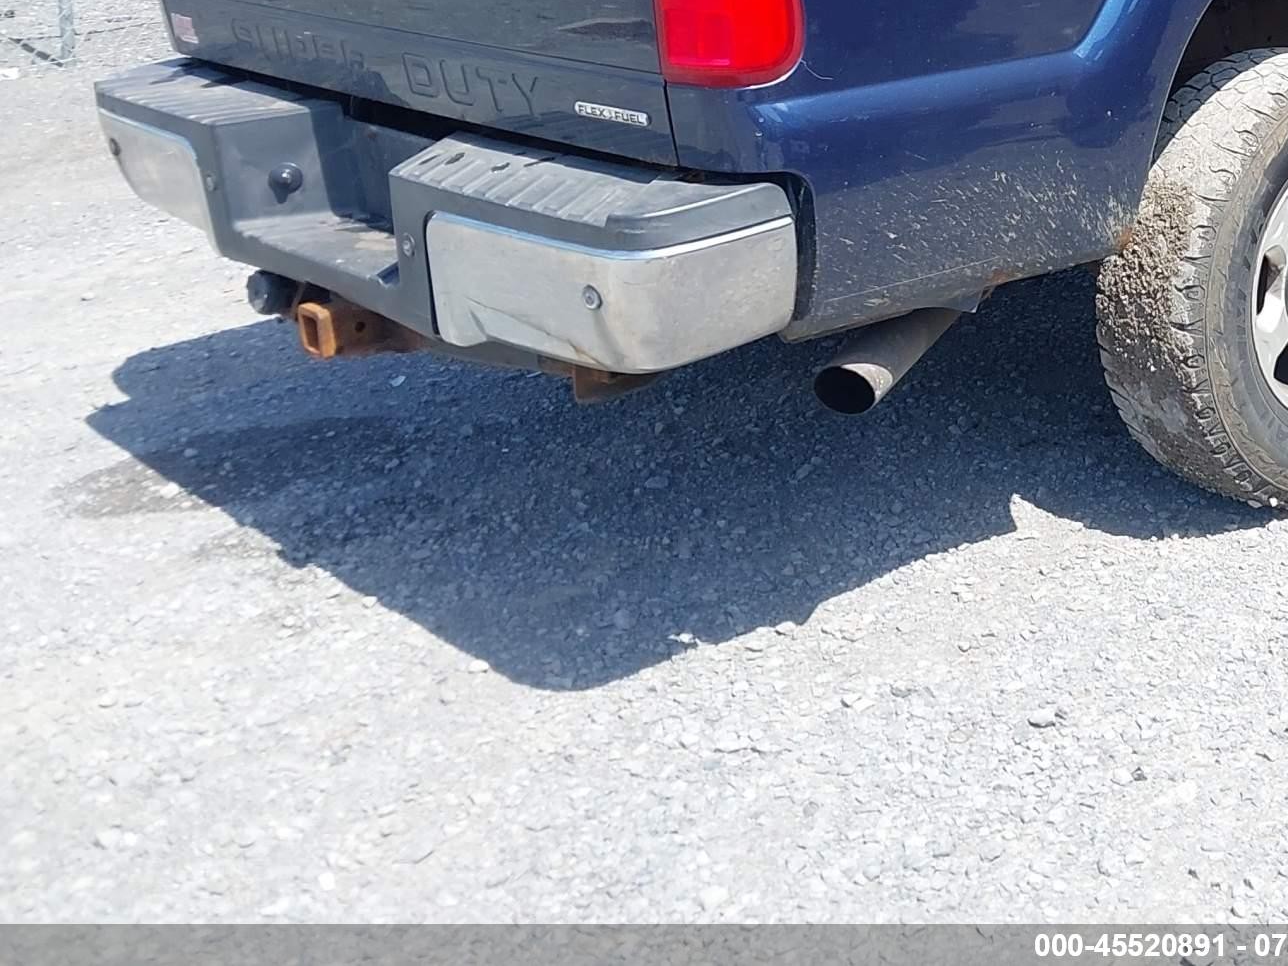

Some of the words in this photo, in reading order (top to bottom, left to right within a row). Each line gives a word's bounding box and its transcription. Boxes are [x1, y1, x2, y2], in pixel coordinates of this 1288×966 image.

[402, 52, 539, 119] DUTY
[578, 103, 605, 118] FLEX
[614, 110, 645, 125] FUEL
